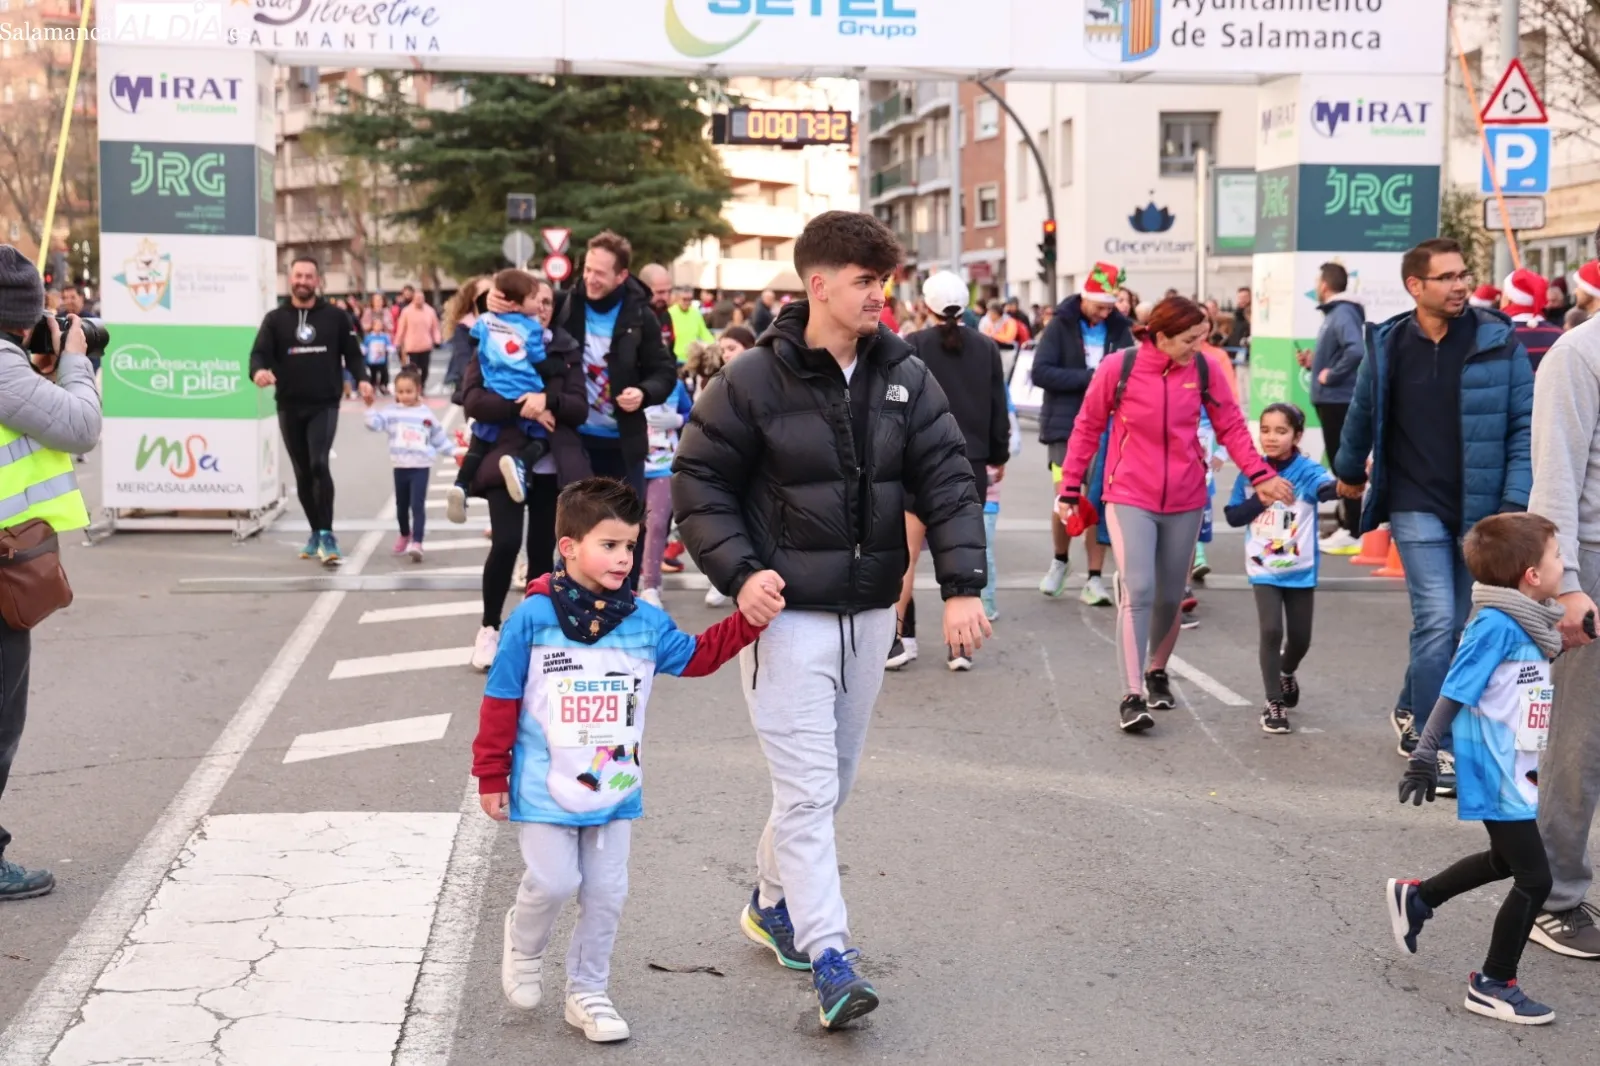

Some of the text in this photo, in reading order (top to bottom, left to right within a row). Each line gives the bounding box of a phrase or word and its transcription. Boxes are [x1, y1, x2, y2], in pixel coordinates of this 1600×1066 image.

[227, 28, 441, 51] SALMANTINA
[838, 20, 917, 40] Grupo
[1171, 22, 1382, 50] de Salamanca
[130, 144, 226, 197] JRG
[1495, 133, 1538, 188] P
[1324, 167, 1413, 216] JRG
[151, 371, 242, 396] el pilar
[116, 480, 245, 494] MERCASALAMANCA
[573, 680, 629, 692] SETEL
[560, 694, 619, 723] 6629
